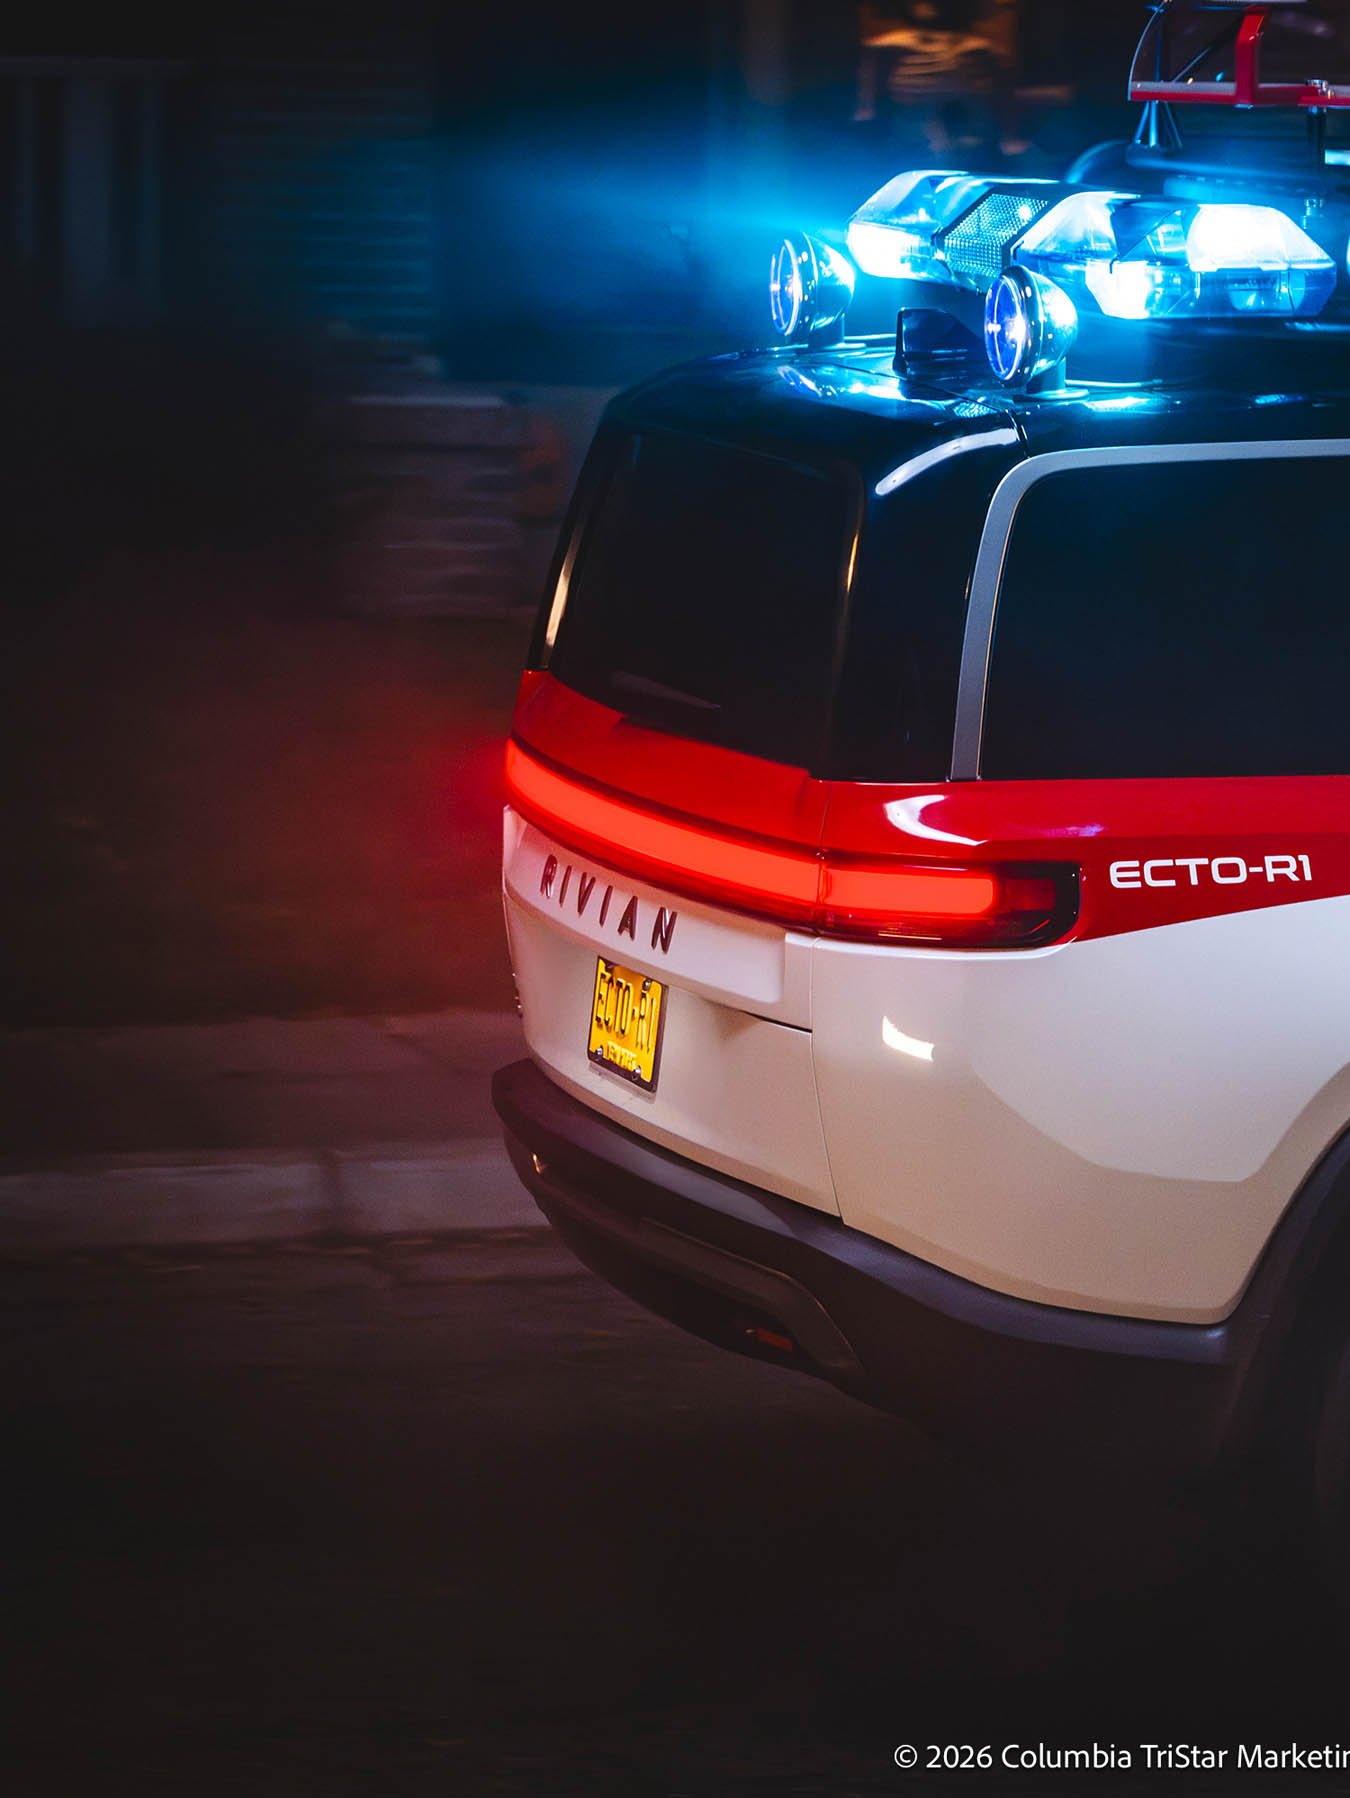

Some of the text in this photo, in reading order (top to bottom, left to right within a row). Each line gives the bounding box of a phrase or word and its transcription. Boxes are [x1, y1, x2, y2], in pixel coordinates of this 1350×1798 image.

[540, 854, 678, 954] RIVIAN
[1109, 854, 1313, 889] ECTO-R1
[595, 972, 658, 1053] ECTO-R1
